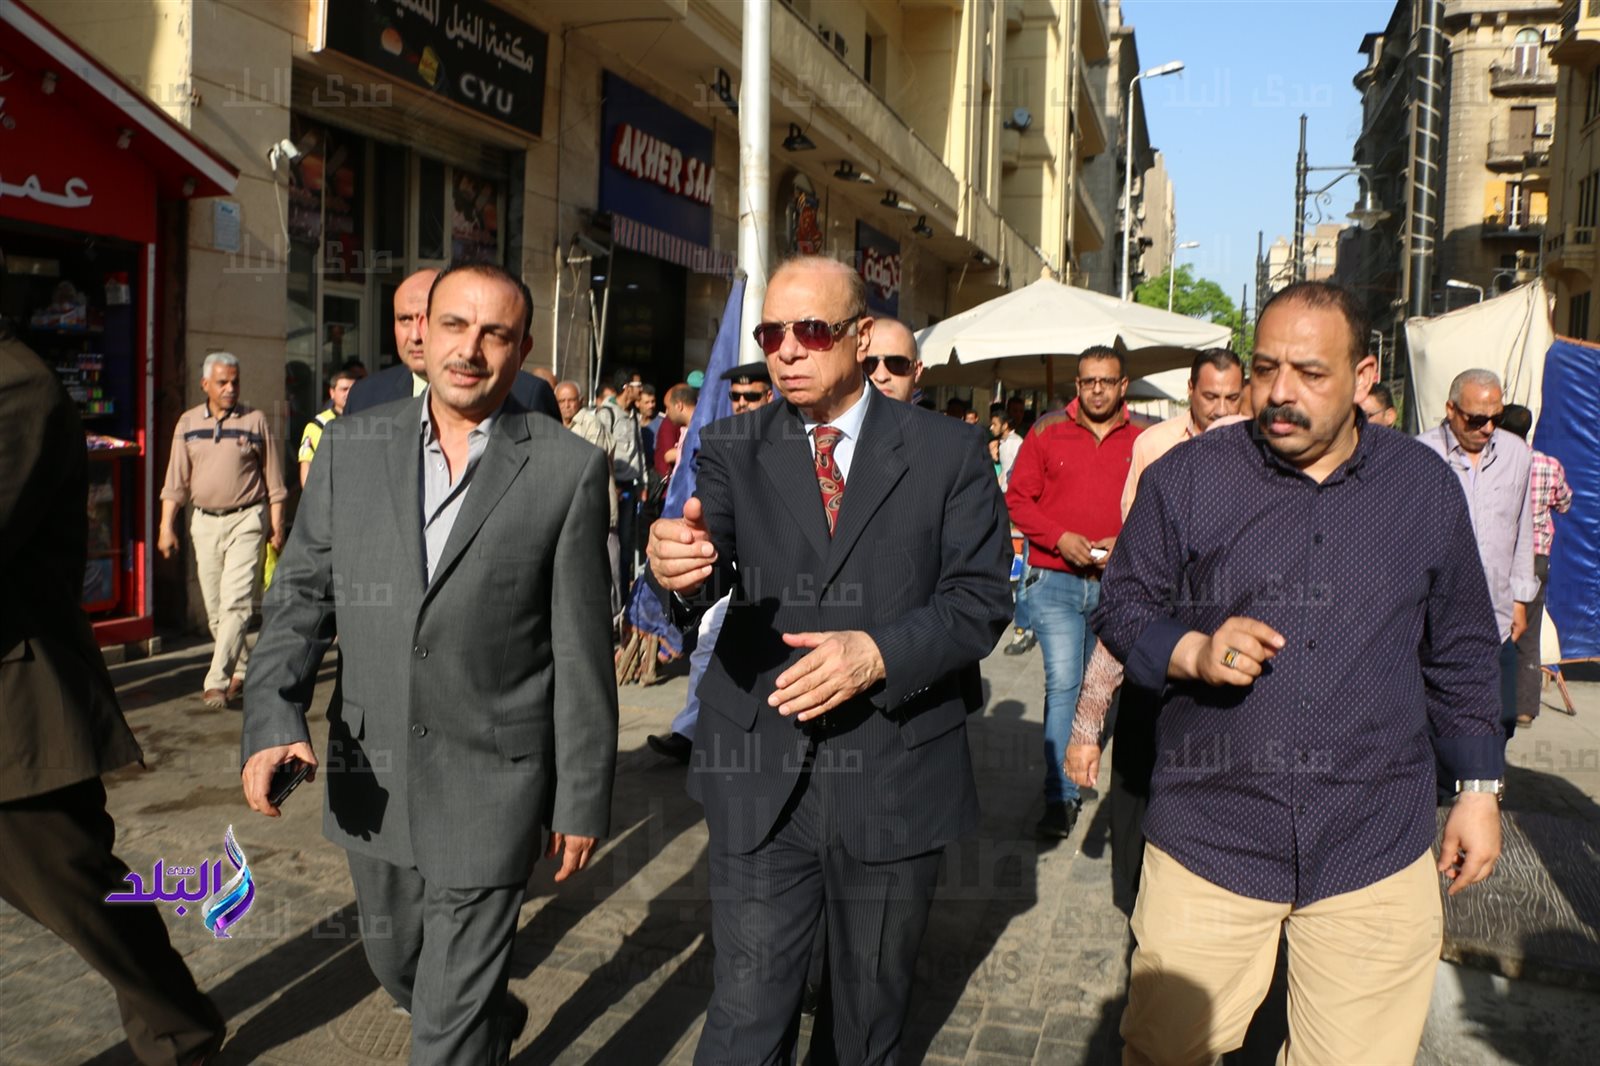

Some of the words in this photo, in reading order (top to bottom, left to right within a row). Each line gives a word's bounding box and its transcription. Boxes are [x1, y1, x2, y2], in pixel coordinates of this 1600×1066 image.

[445, 4, 483, 49] النيل
[486, 22, 534, 74] مكتبة
[460, 73, 515, 115] CYU
[618, 123, 683, 195] AKHER
